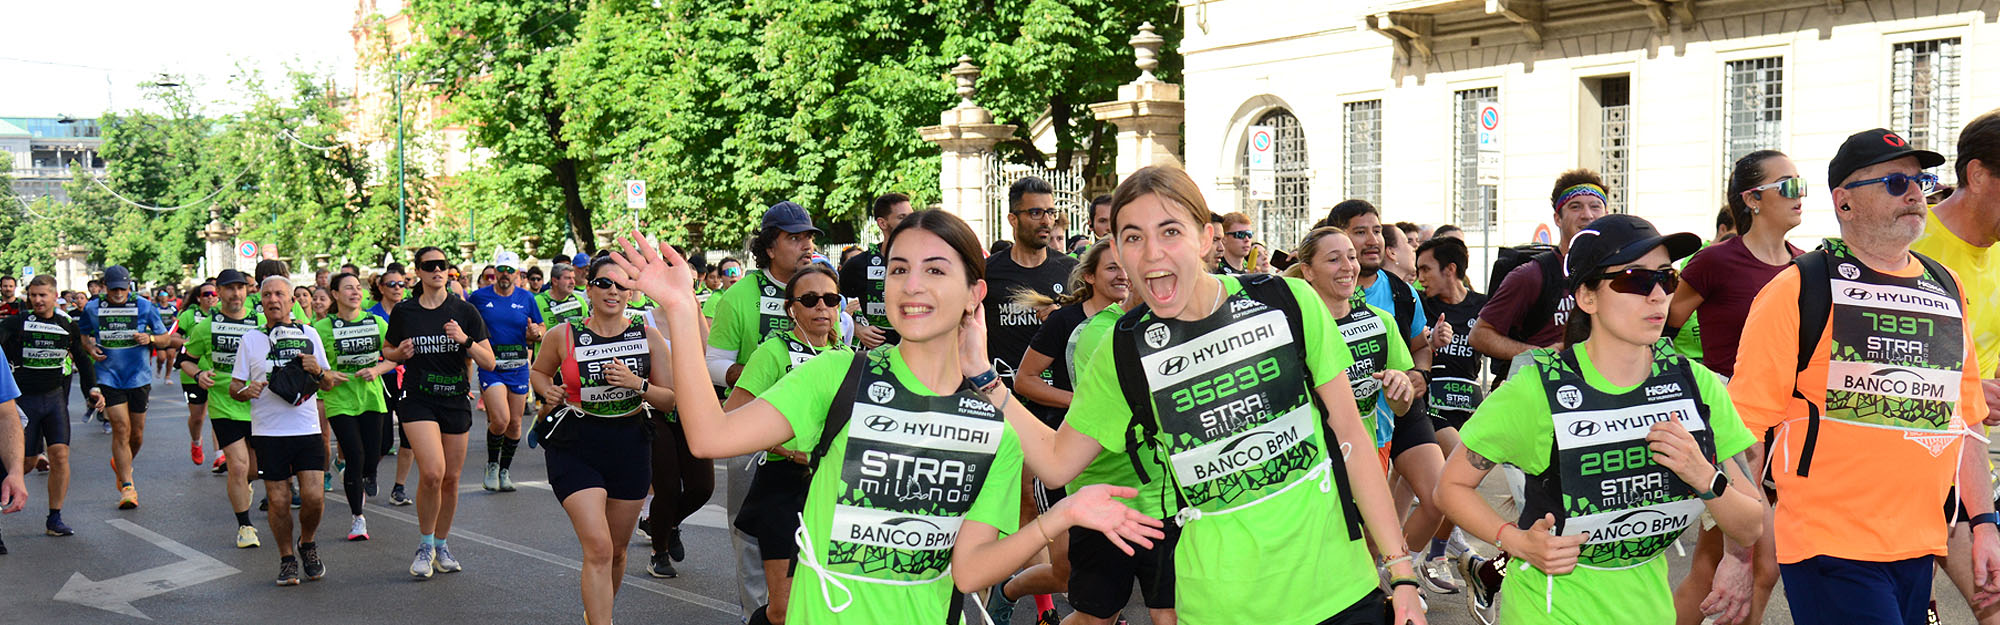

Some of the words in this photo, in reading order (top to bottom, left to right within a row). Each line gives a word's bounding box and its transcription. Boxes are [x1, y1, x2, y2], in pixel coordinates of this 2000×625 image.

[1876, 292, 1949, 310] HYUNDAI
[1341, 322, 1378, 338] YUNDAI
[1862, 312, 1934, 336] 7337
[217, 336, 242, 345] STR
[341, 337, 372, 348] STRA
[602, 343, 643, 354] HYUNDAI
[1192, 323, 1275, 364] HYUNDAI
[1867, 336, 1923, 354] STRA
[590, 391, 624, 401] BANCO
[1171, 357, 1281, 413] 35239
[1443, 383, 1473, 393] 4844
[1645, 382, 1682, 397] HOKA
[1844, 376, 1907, 394] BANCO
[1911, 382, 1945, 398] BPM
[958, 397, 996, 413] HOKA
[1446, 393, 1470, 402] STRA
[1200, 393, 1263, 428] STRA
[903, 421, 990, 444] HYUNDAI
[1193, 442, 1263, 480] BANCO
[1269, 426, 1299, 455] BPM
[860, 449, 966, 487] STRA
[961, 463, 976, 502] 2026
[1600, 472, 1662, 496] STRA
[850, 523, 922, 547] BANCO
[924, 530, 957, 547] BPM
[1581, 521, 1647, 541] ANCO
[1651, 514, 1688, 533] BPM
